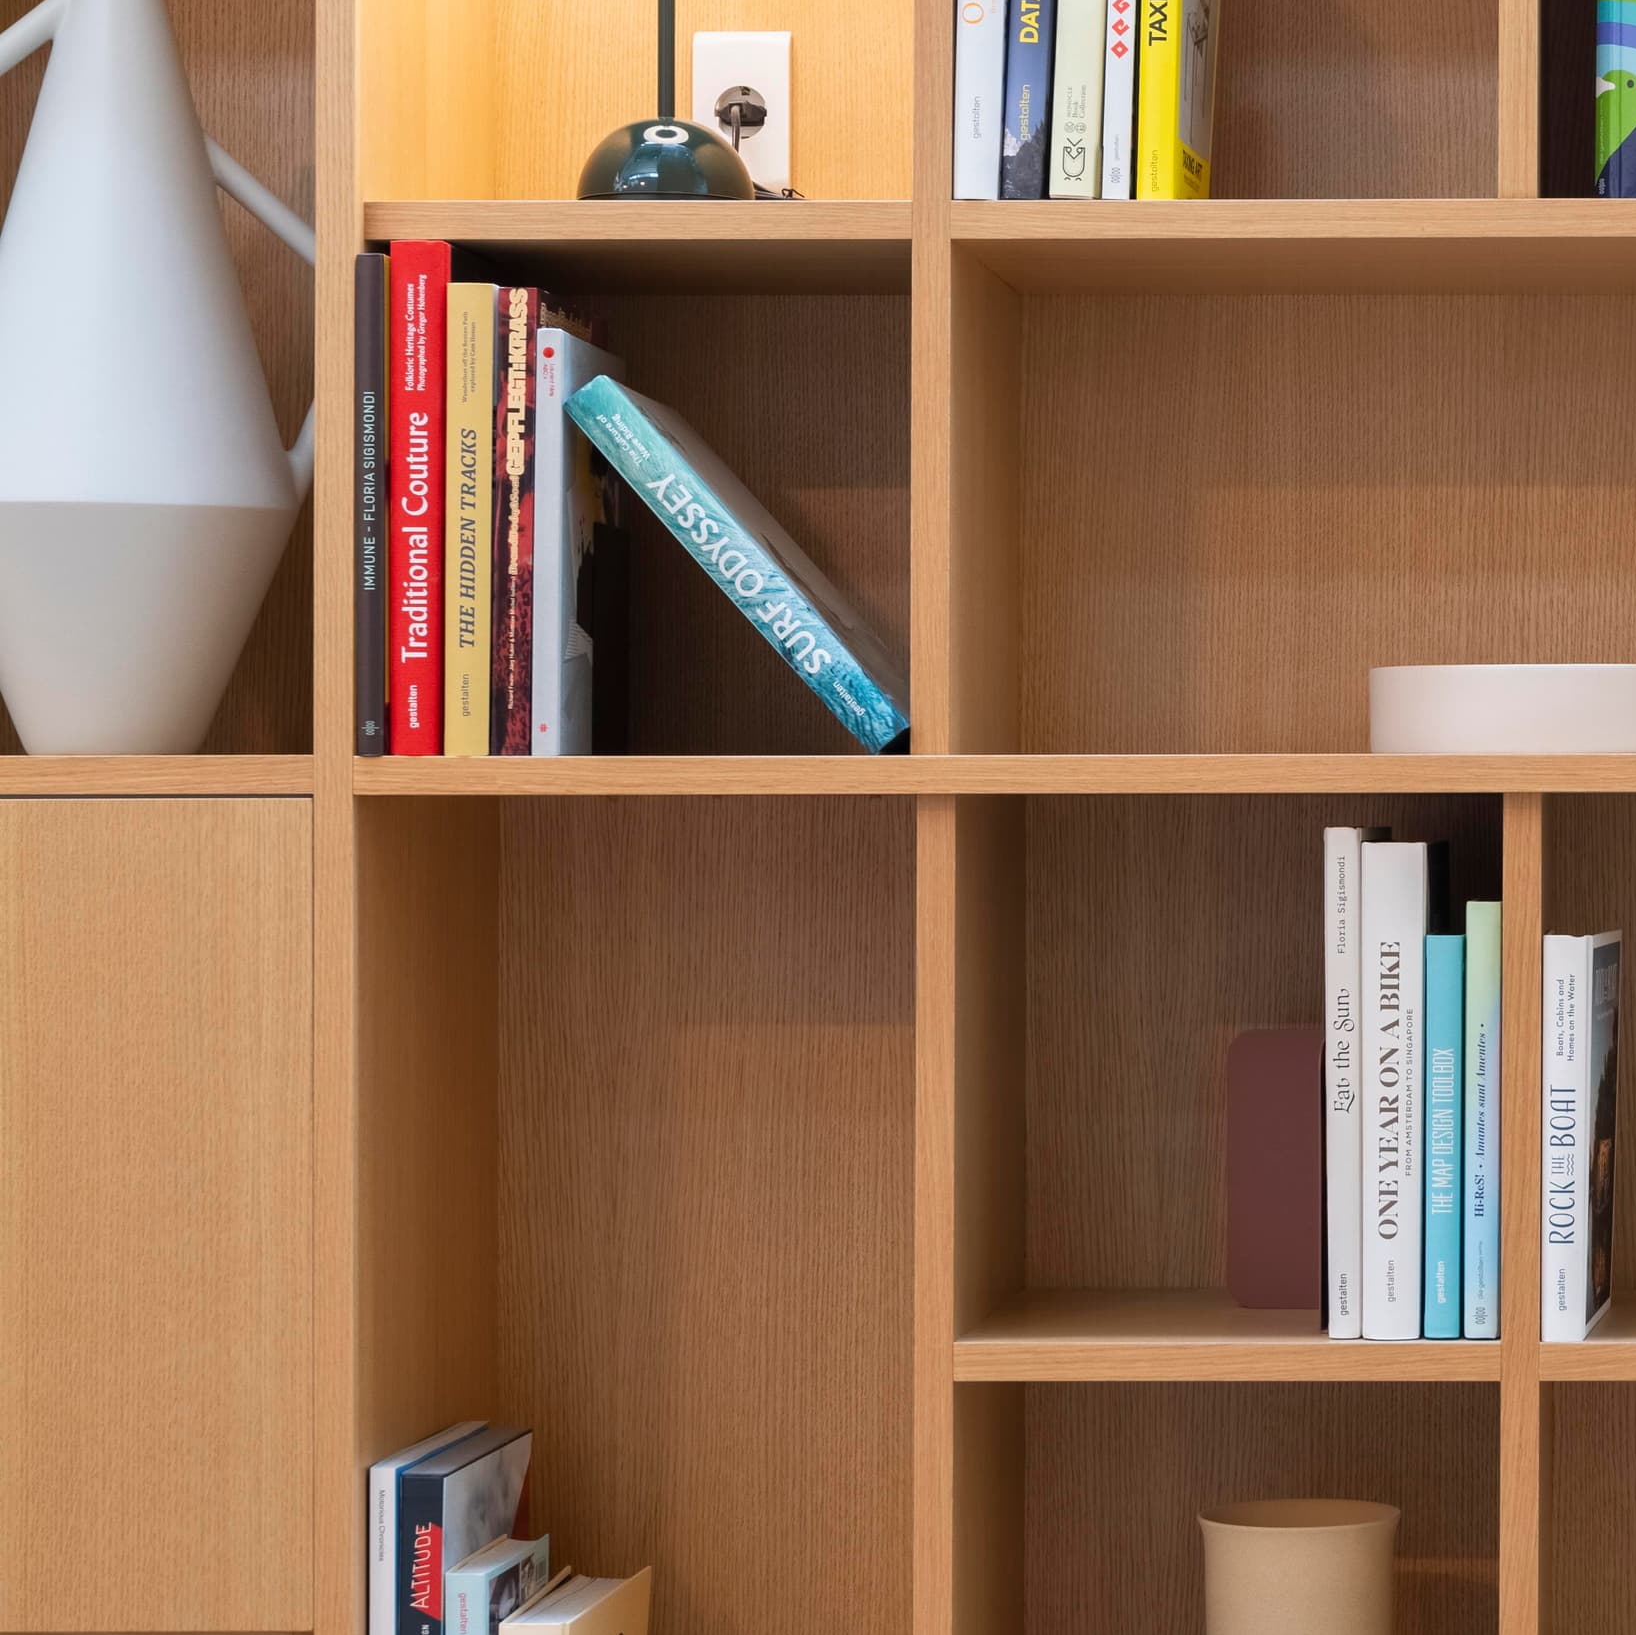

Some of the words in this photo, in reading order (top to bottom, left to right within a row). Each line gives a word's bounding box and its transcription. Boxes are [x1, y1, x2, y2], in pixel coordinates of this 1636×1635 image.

[972, 96, 983, 138] gestalten
[1150, 150, 1160, 192] gestalten
[363, 391, 375, 469] SIGISMONDI
[402, 412, 428, 516] Couture
[461, 429, 477, 510] TRACKS
[363, 473, 375, 521] FLORIA
[460, 517, 475, 600] HIDDEN
[646, 473, 764, 597] ODYSSEY
[364, 537, 375, 590] IMMUNE
[402, 527, 427, 663] Traditional
[460, 605, 474, 647] THE
[756, 600, 832, 674] SURF
[408, 685, 419, 728] gestalten
[1337, 856, 1347, 913] Sigismondi
[1337, 920, 1346, 954] Floria
[1380, 942, 1400, 1011] BIKE
[1334, 988, 1355, 1032] Sun
[1380, 1019, 1400, 1039] A
[1333, 1041, 1350, 1068] the
[1379, 1047, 1400, 1087] ON
[1406, 1069, 1413, 1081] TO
[1432, 1048, 1454, 1103] TOOLBOX
[1334, 1078, 1355, 1113] Eat
[1405, 1085, 1413, 1146] AMSTERDAM
[1477, 1084, 1486, 1108] sunt
[1550, 1084, 1576, 1146] BOAT
[1379, 1095, 1399, 1172] YEAR
[1432, 1109, 1454, 1154] DESIGN
[1475, 1111, 1485, 1159] Amantes
[1432, 1159, 1453, 1187] MAP
[1552, 1156, 1566, 1175] THE
[1378, 1180, 1398, 1240] ONE
[1432, 1193, 1453, 1214] THE
[1474, 1174, 1484, 1217] Hi-ReS!
[1549, 1180, 1576, 1244] ROCK
[409, 1522, 432, 1609] ALTITUDE
